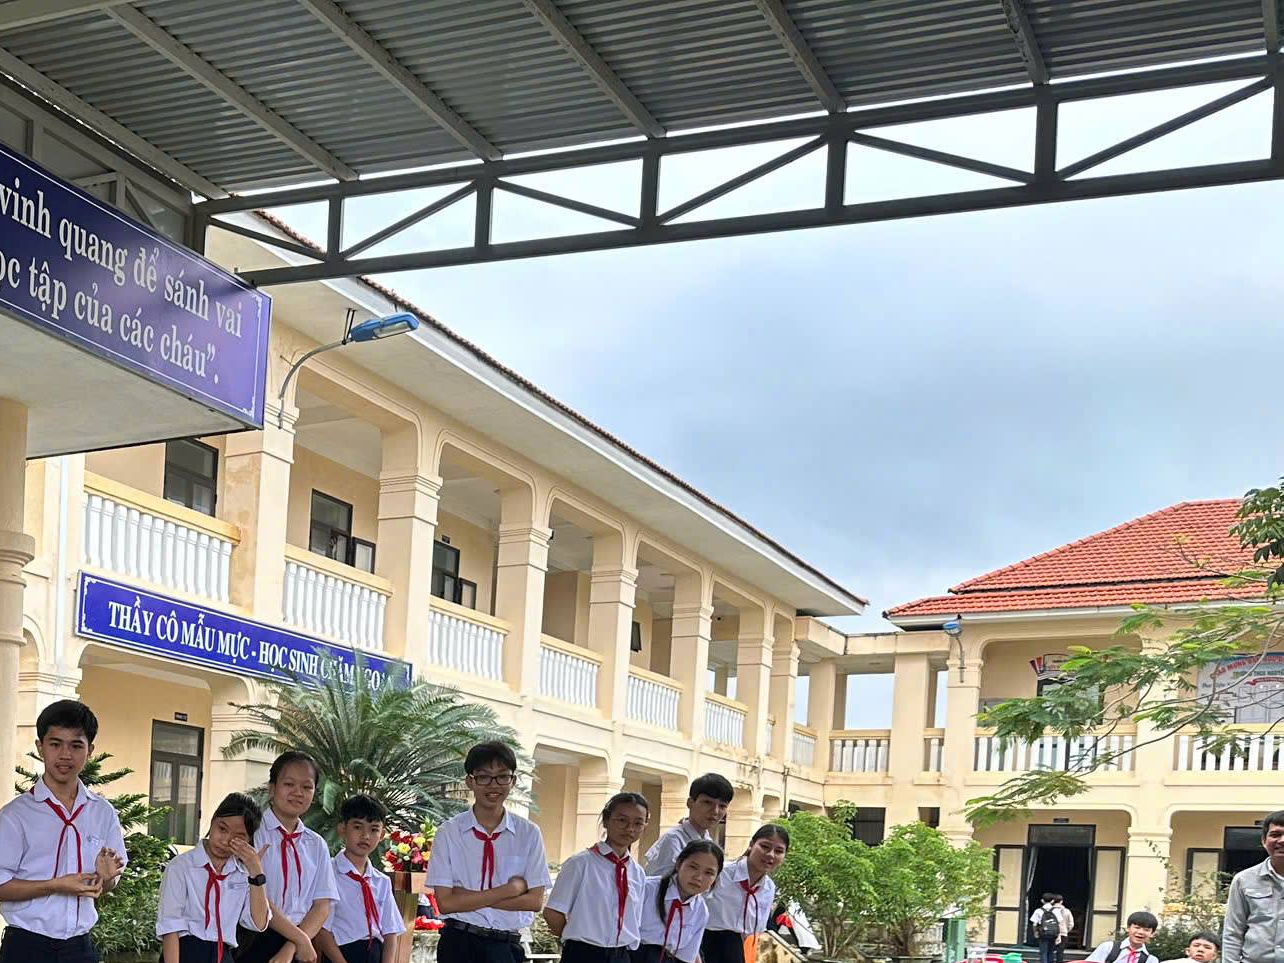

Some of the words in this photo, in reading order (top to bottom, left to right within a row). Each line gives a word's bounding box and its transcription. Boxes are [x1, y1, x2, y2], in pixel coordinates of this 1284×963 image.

[28, 257, 67, 320] tập
[73, 282, 113, 335] của
[119, 307, 155, 353] các
[58, 217, 128, 286] quang
[133, 246, 160, 294] để
[164, 268, 210, 321] sánh
[215, 301, 242, 338] vai
[107, 595, 154, 636] THẦY
[156, 609, 179, 643] CÔ
[180, 612, 216, 652] MẪU
[216, 630, 251, 664] MỰC
[257, 640, 288, 672] HỌC
[288, 648, 320, 677] SINH
